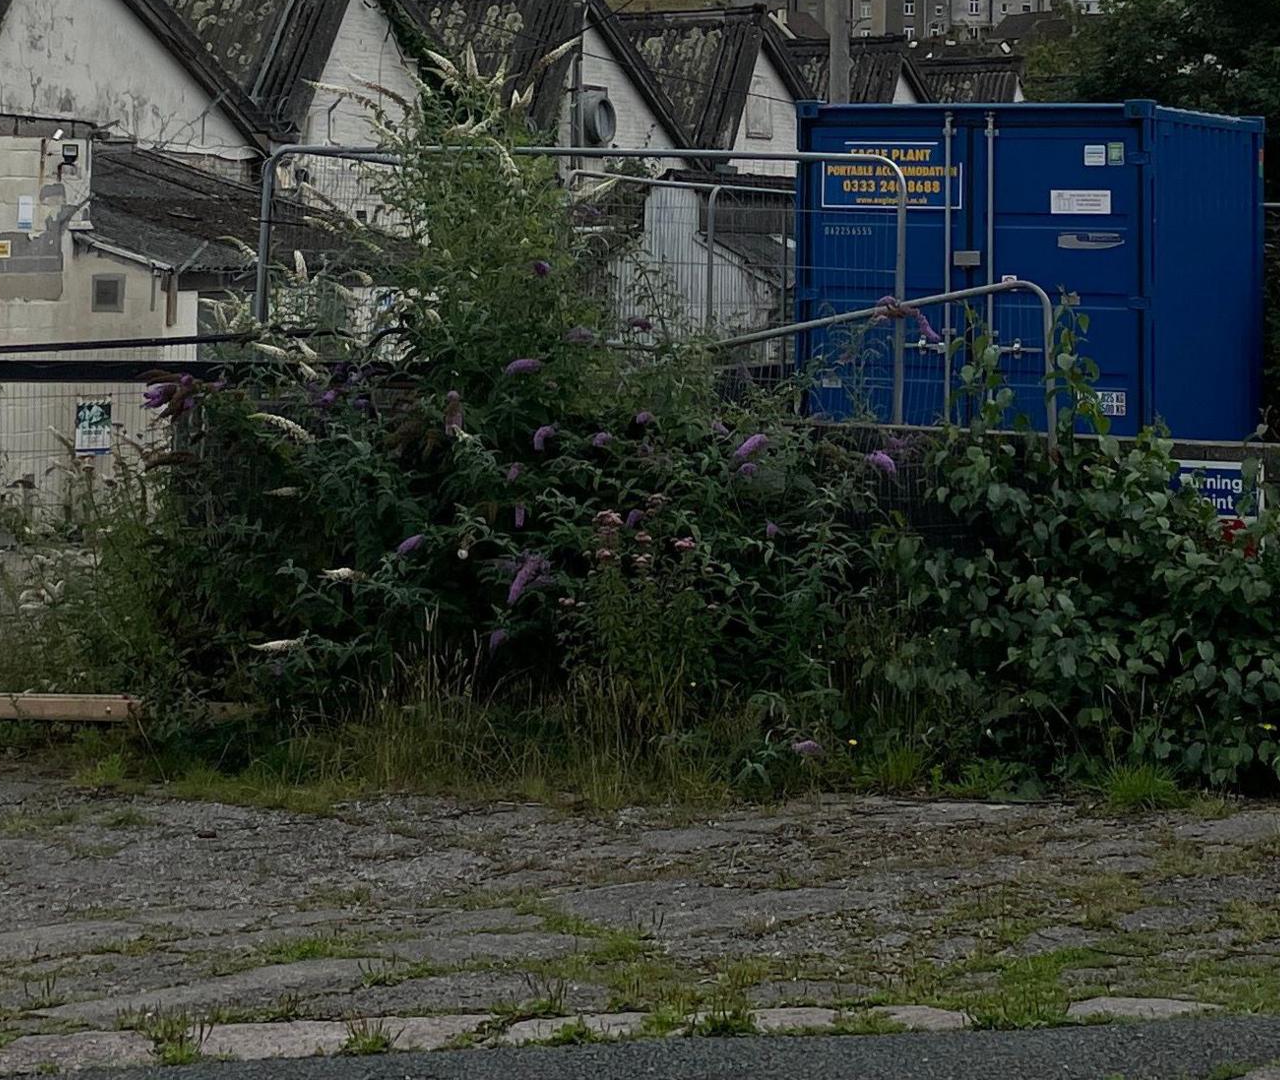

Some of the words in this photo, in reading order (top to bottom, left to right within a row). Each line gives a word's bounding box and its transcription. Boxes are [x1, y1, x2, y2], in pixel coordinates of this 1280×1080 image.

[892, 149, 931, 161] PLANT
[827, 165, 873, 176] PORTABLE
[875, 166, 957, 177] ACCMMODATIN
[842, 180, 875, 193] 0333
[907, 181, 940, 193] 8688
[1192, 494, 1233, 510] oint
